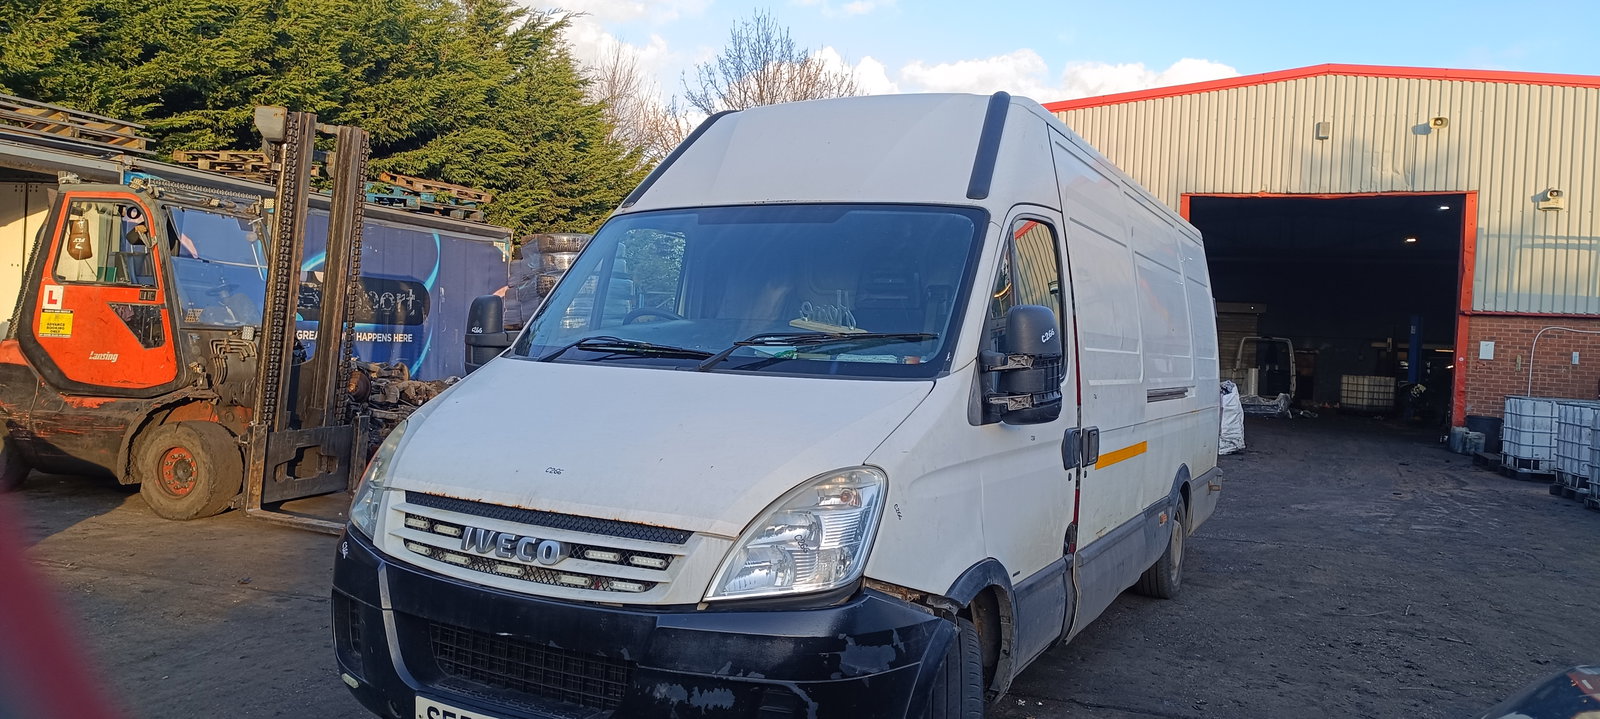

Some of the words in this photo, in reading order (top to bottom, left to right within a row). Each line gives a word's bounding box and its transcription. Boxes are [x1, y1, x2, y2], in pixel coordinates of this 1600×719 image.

[47, 290, 58, 304] L
[356, 331, 392, 342] HAPPENS
[393, 333, 413, 342] HERE
[88, 350, 119, 363] Lansing
[461, 526, 564, 566] IVECO
